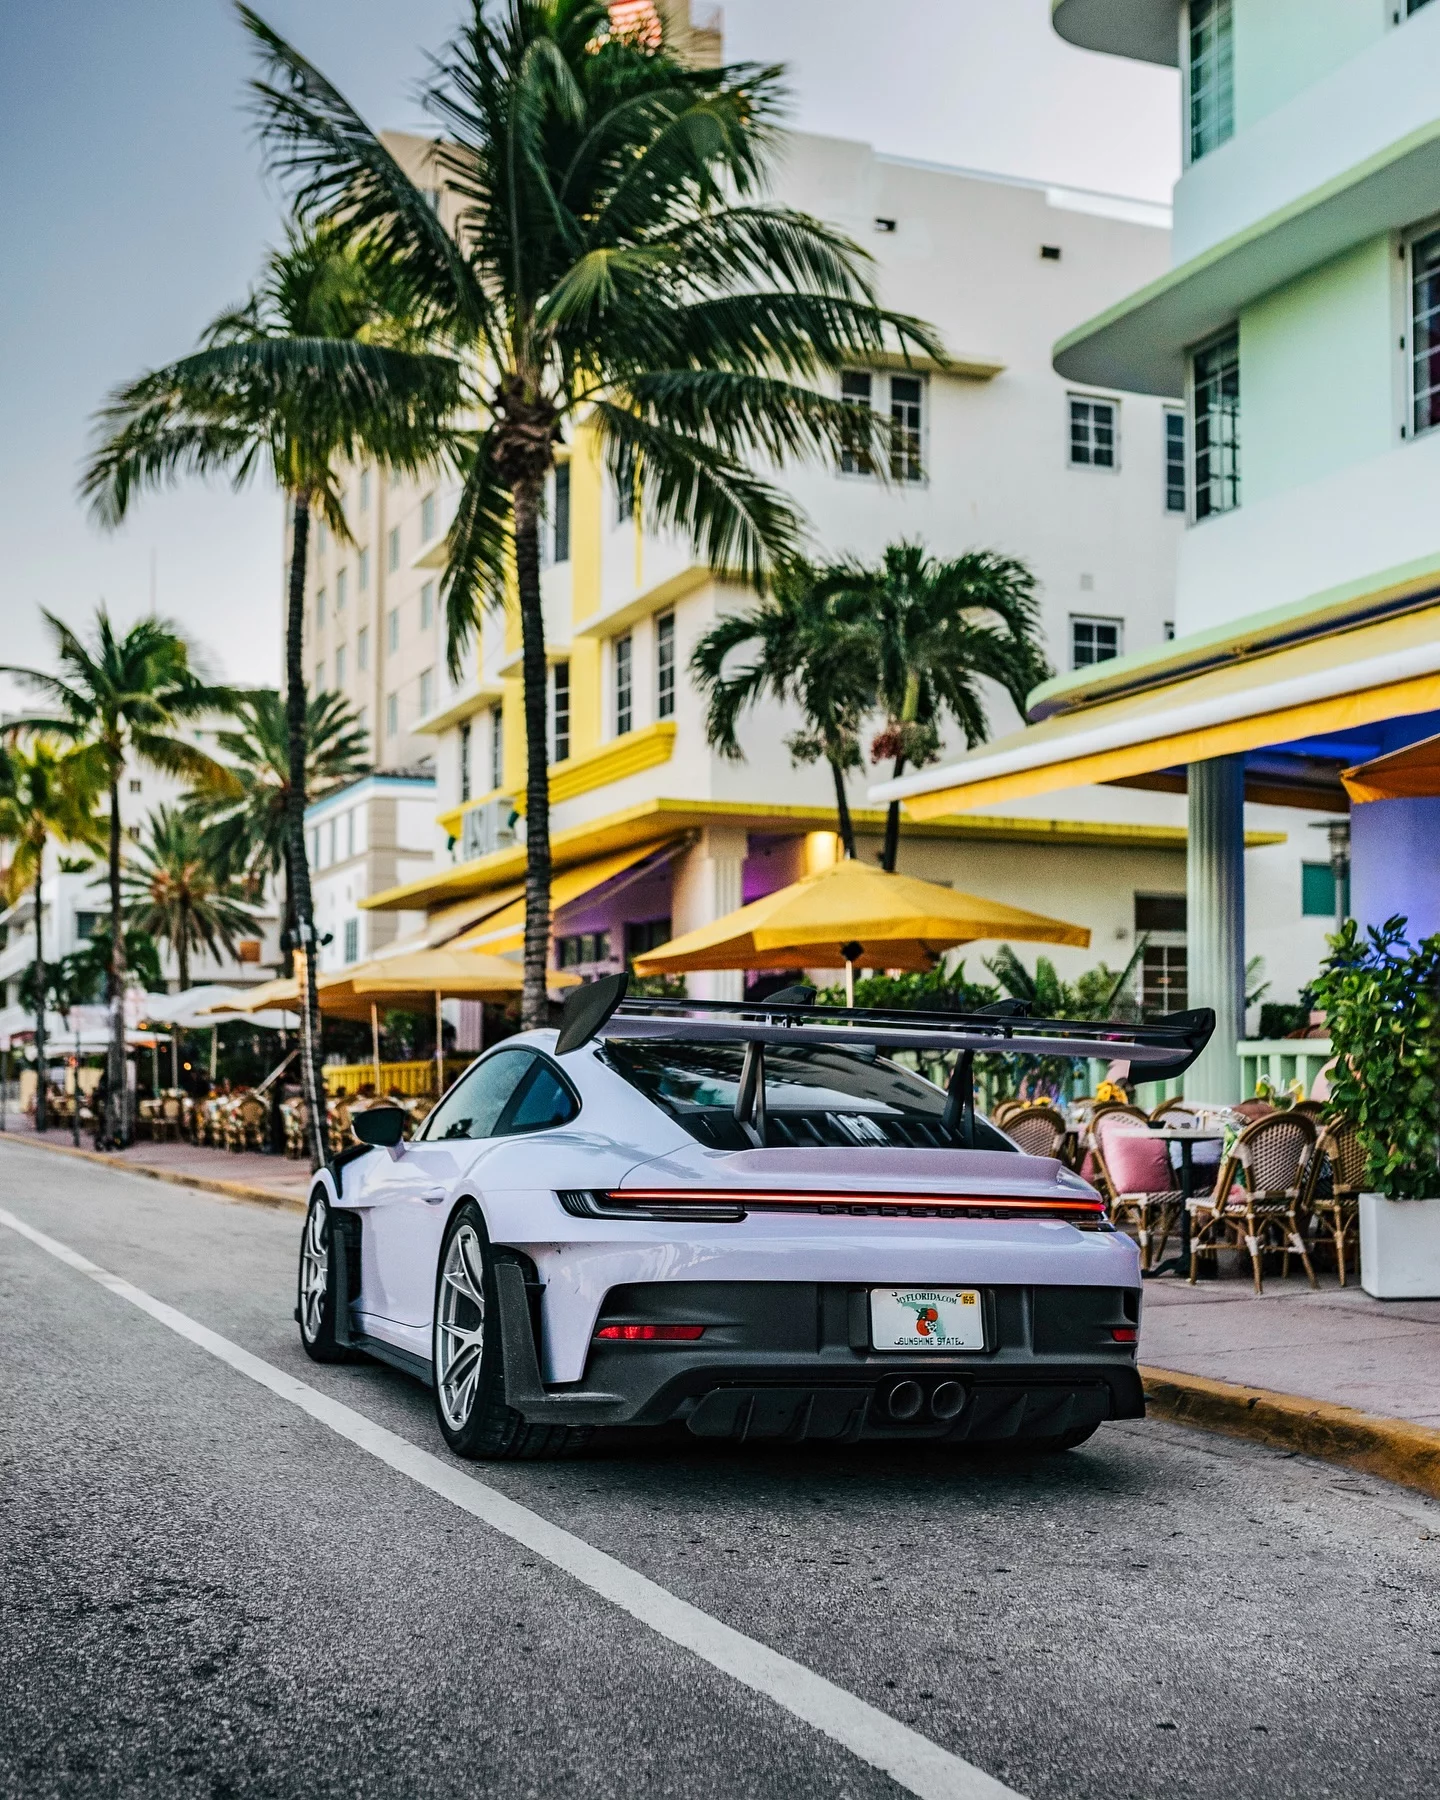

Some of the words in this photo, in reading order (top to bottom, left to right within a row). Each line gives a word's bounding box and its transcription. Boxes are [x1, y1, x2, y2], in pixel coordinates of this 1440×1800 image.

[896, 1292, 957, 1304] MYFLORIDA.COM
[899, 1337, 934, 1346] SUNSHINE
[937, 1337, 959, 1346] STATE
